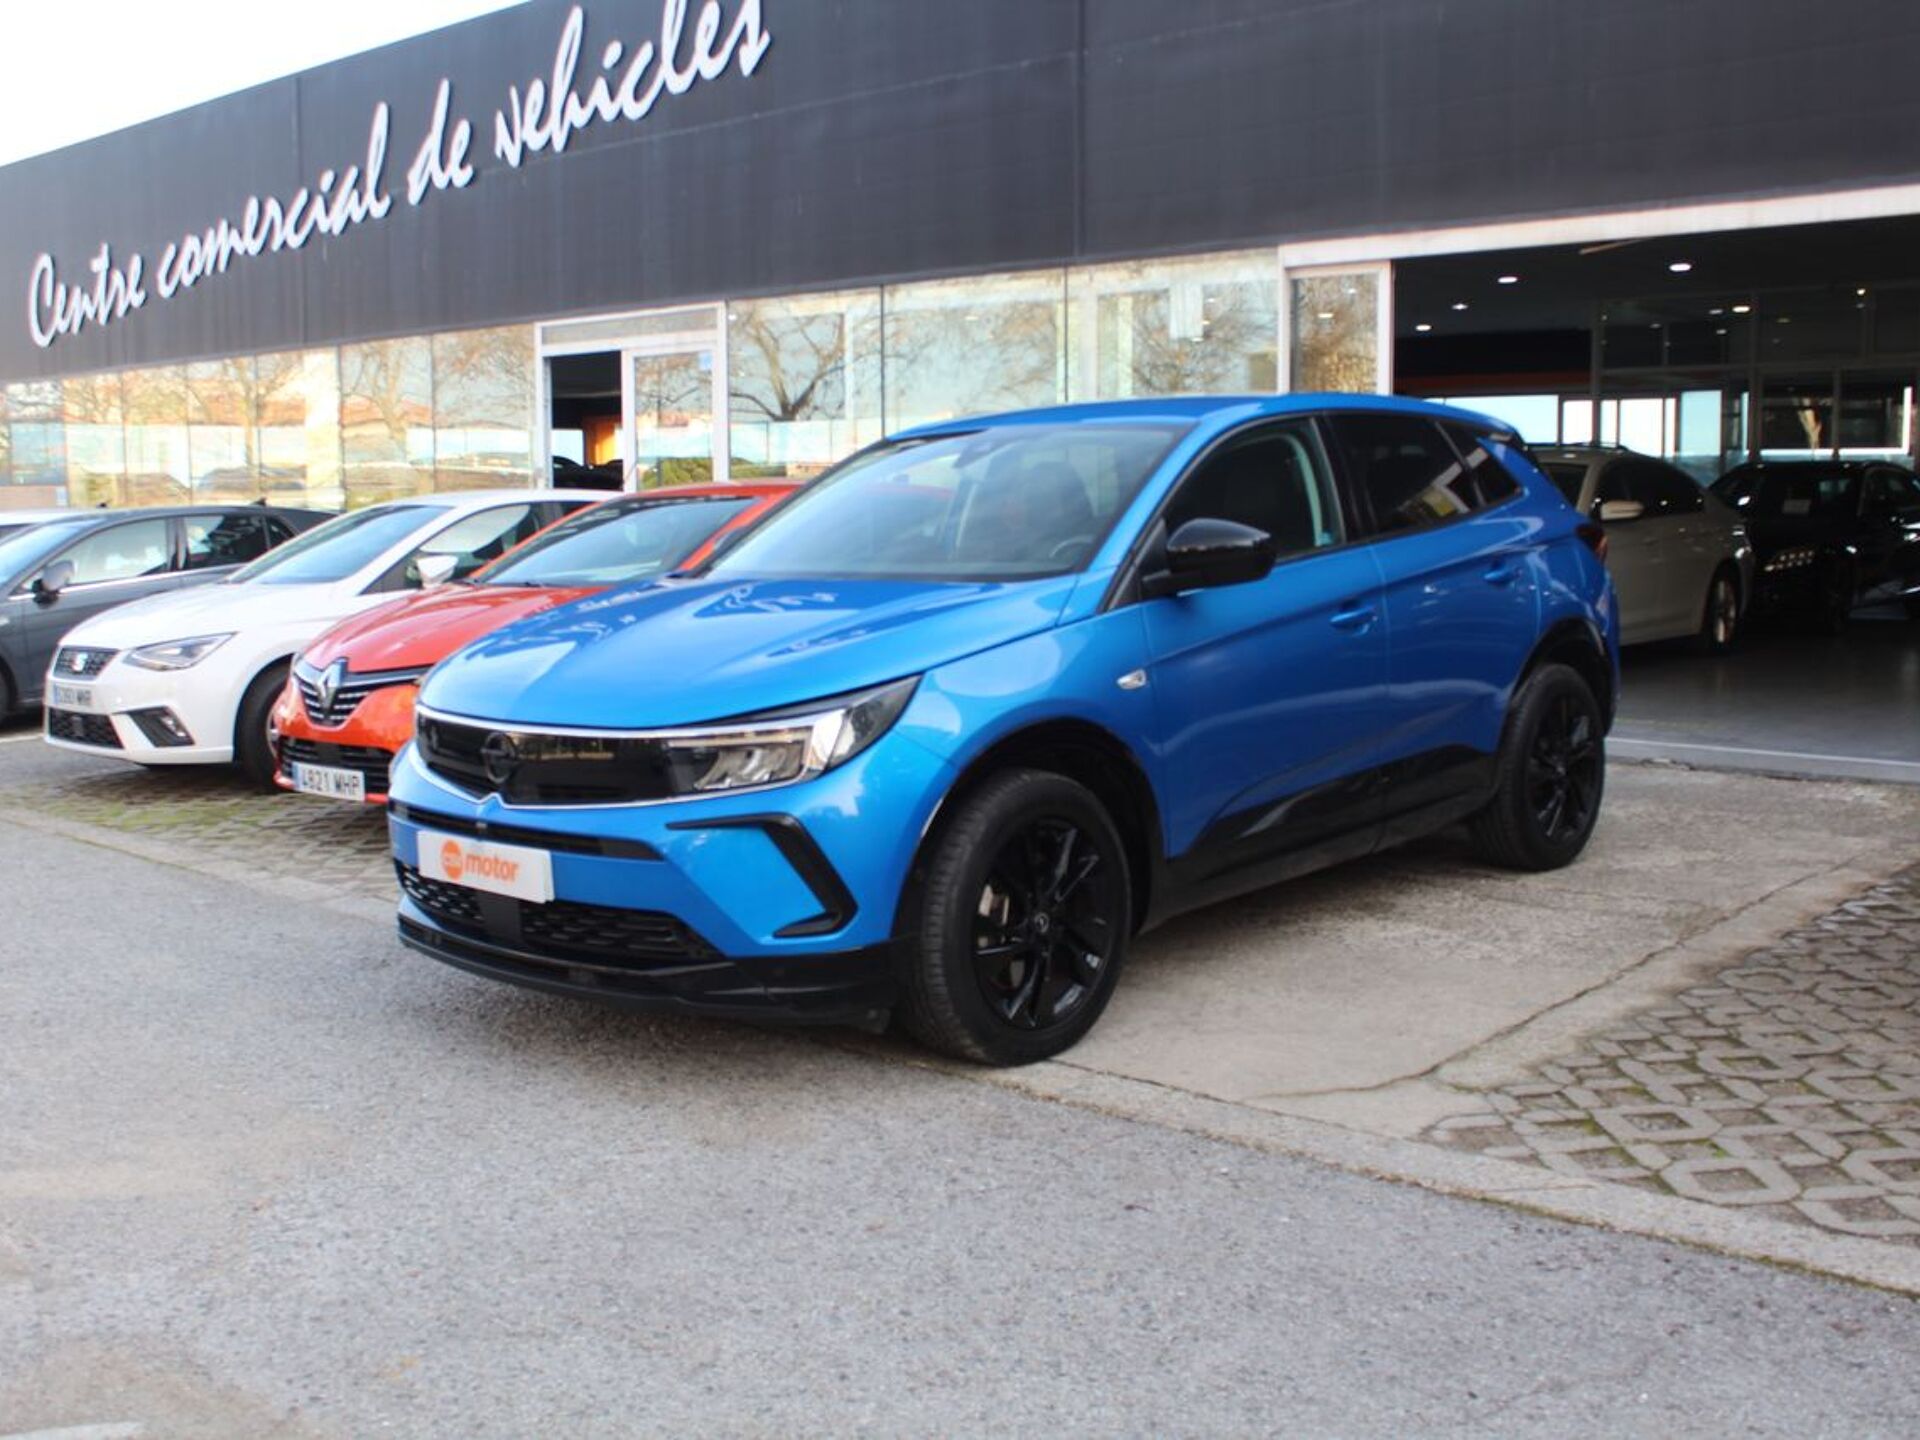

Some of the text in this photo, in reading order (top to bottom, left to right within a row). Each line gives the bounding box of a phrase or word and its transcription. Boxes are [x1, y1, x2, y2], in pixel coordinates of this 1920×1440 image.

[29, 0, 771, 348] Centre comercial de vehicles
[466, 853, 519, 883] motor
